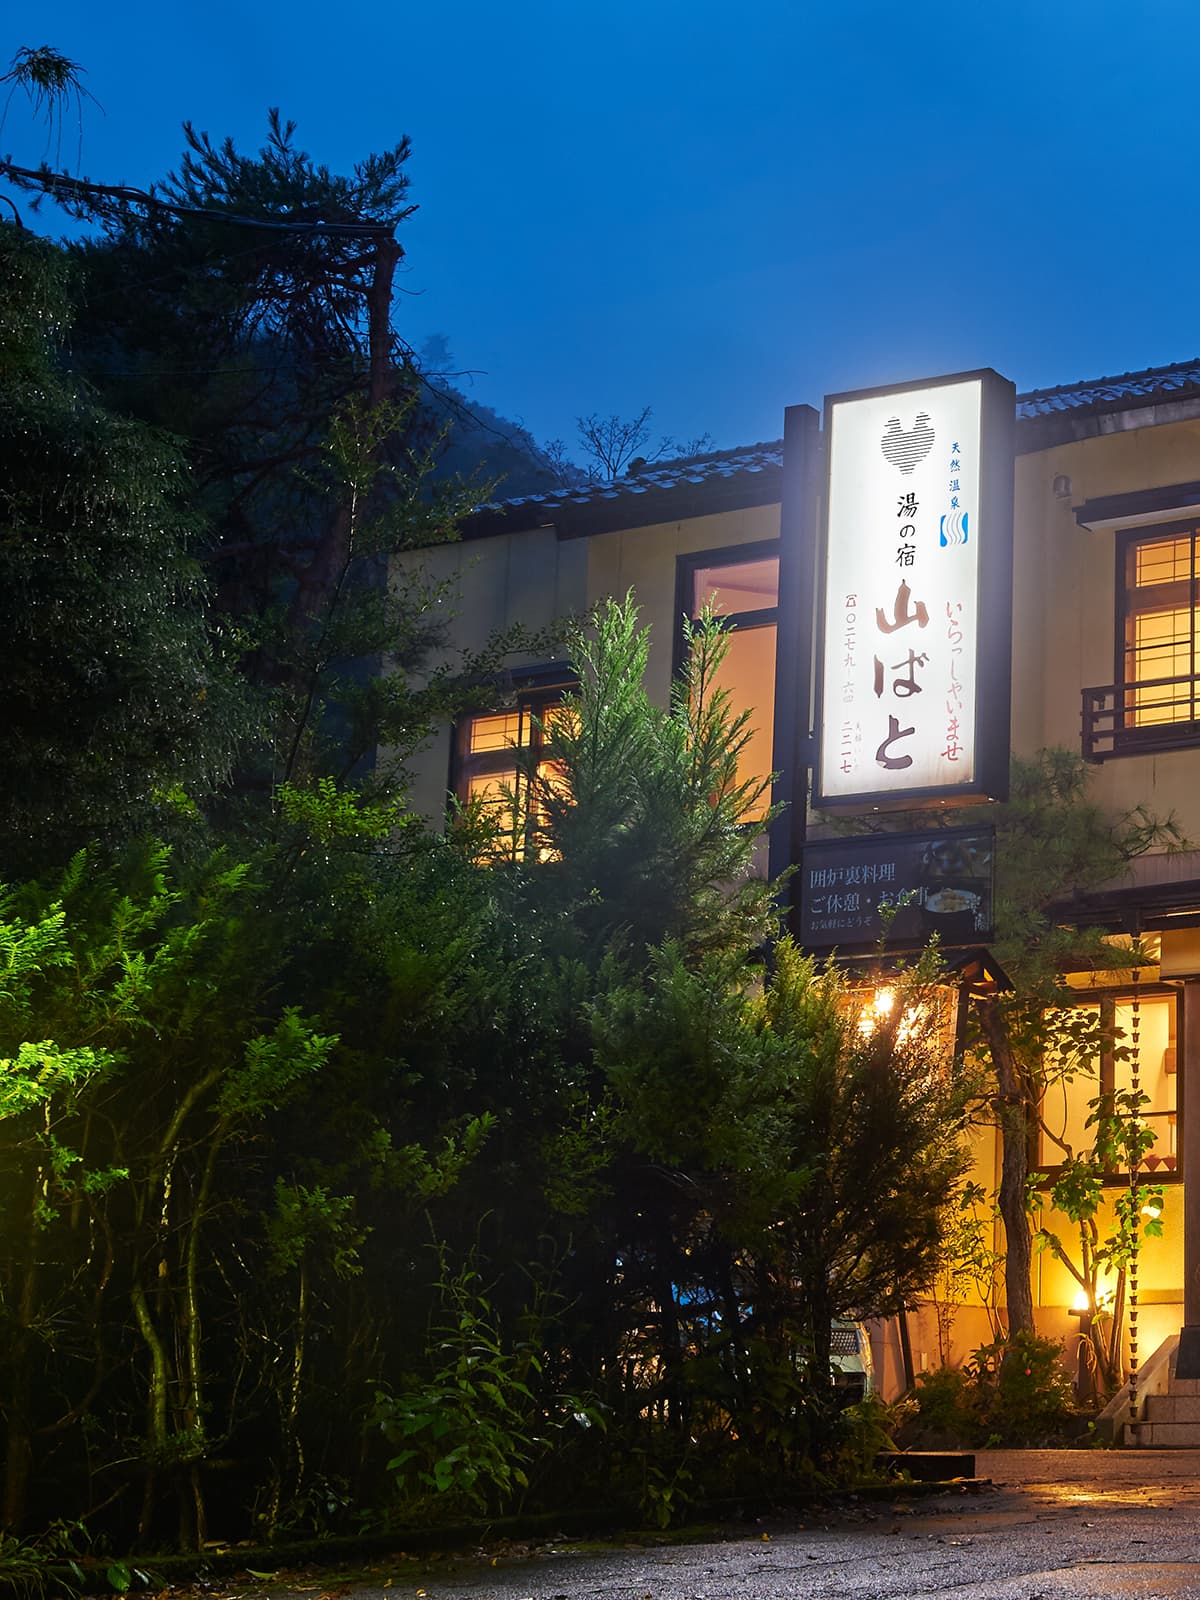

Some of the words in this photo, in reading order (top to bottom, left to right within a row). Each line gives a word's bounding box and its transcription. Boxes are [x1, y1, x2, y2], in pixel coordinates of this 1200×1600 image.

[896, 492, 920, 567] 湯の宿
[949, 442, 961, 510] 天然温泉
[873, 578, 930, 770] 山ばと
[941, 601, 964, 761] いらっしゃいませ
